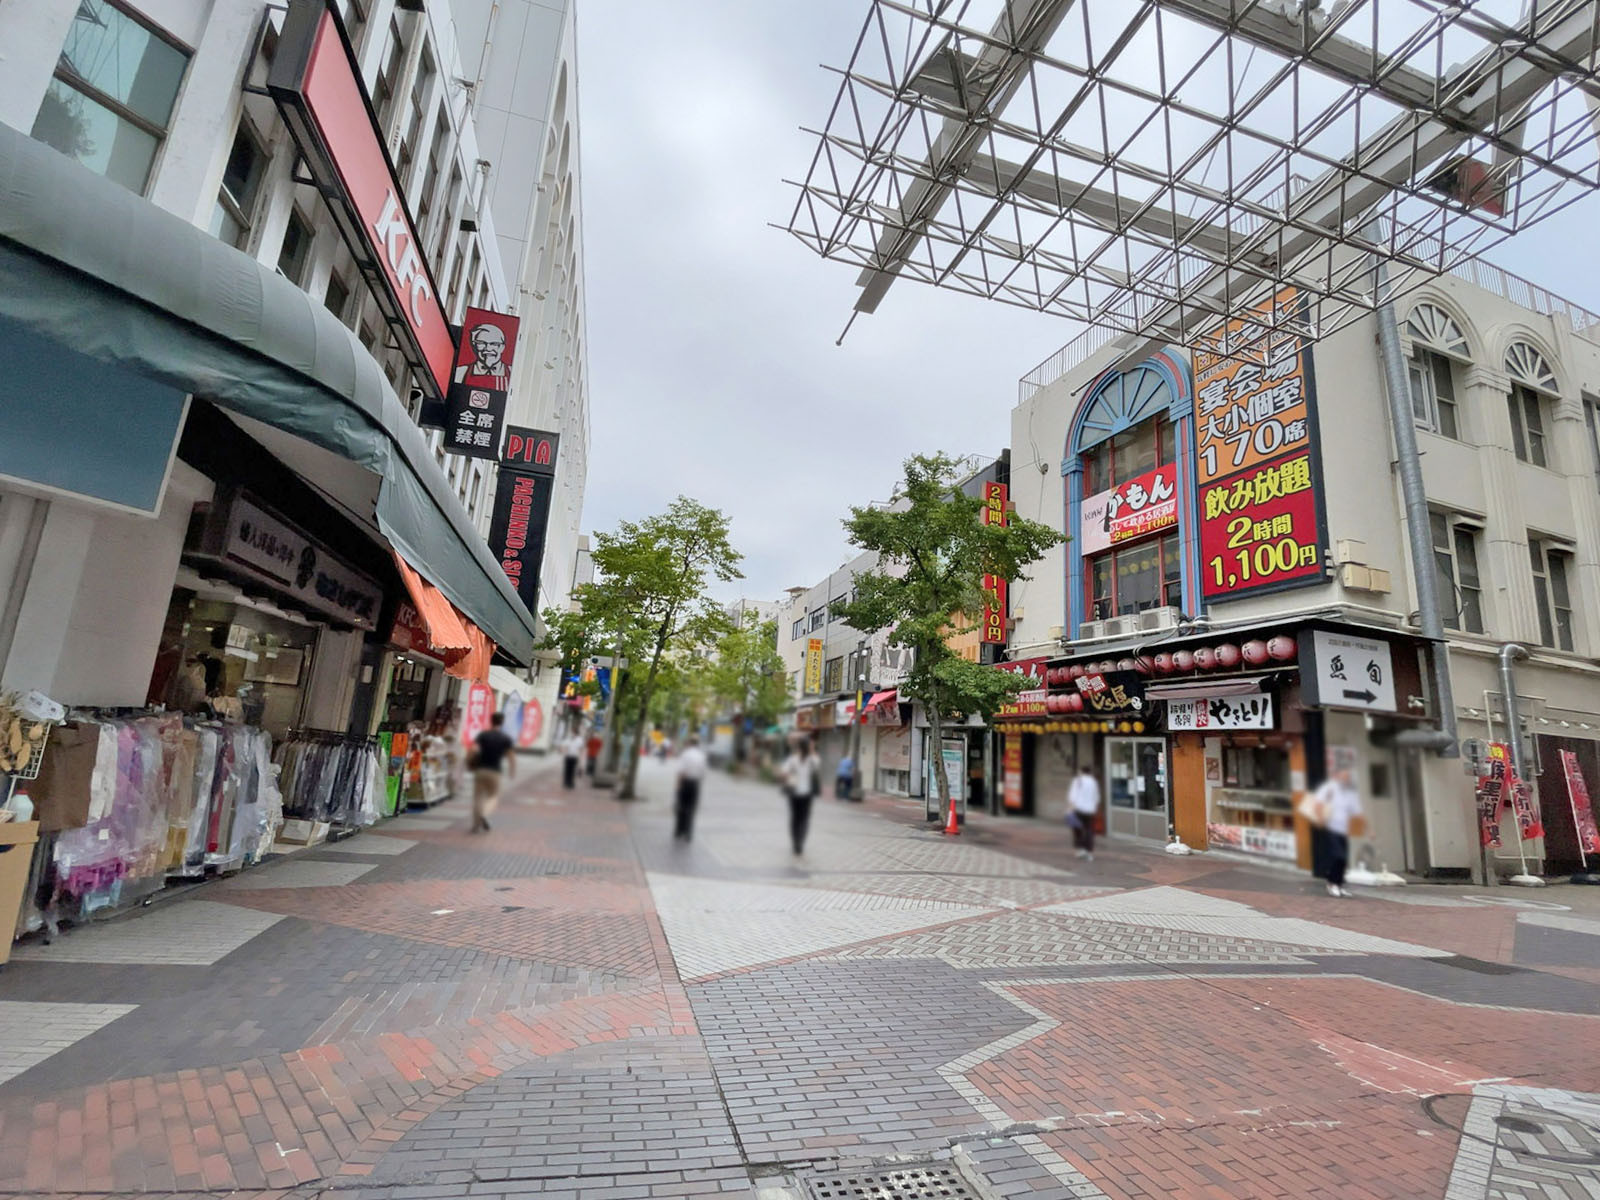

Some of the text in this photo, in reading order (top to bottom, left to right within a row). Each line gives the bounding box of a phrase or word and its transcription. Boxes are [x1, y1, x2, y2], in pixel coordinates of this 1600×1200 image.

[374, 188, 430, 328] KFC
[1199, 338, 1299, 417] 宴会場
[455, 428, 492, 447] 禁煙
[458, 410, 495, 428] 全席
[1199, 376, 1304, 447] 大小個室
[507, 434, 552, 465] PIA
[505, 476, 536, 549] PACHINKO
[1205, 455, 1312, 521] 飲み放題
[1227, 513, 1292, 548] 2時間
[1210, 538, 1317, 587] 1,100円
